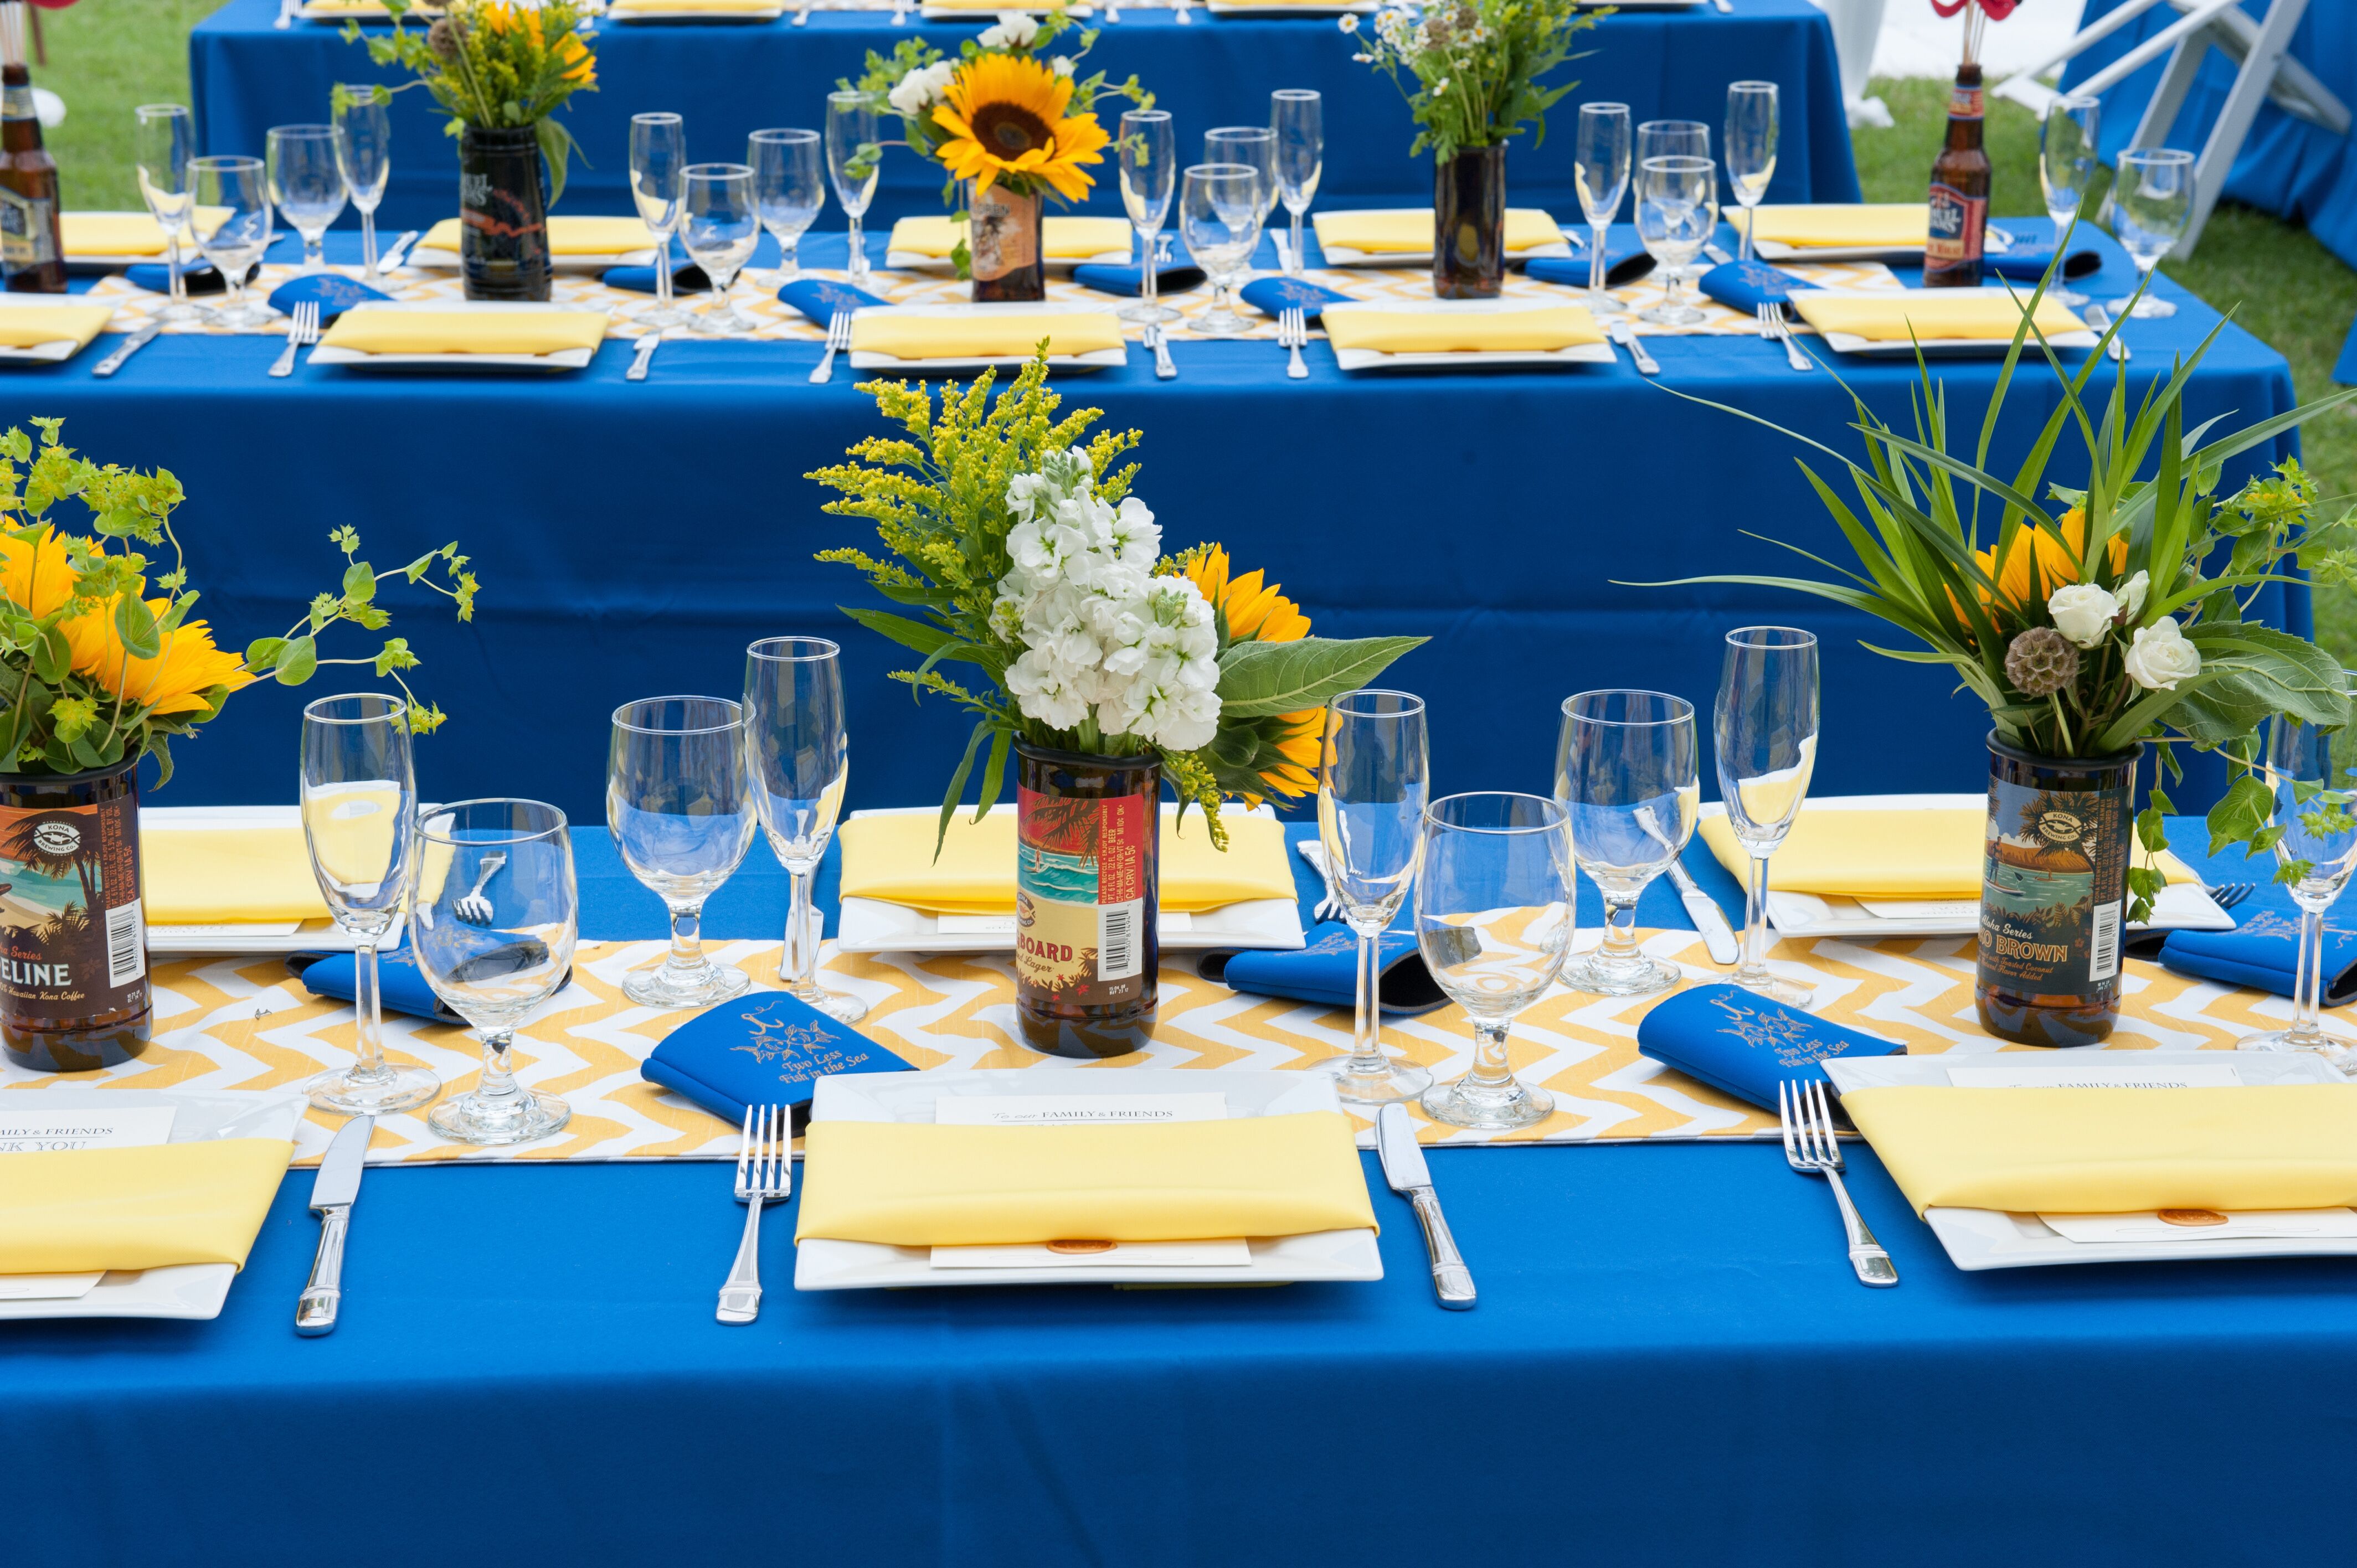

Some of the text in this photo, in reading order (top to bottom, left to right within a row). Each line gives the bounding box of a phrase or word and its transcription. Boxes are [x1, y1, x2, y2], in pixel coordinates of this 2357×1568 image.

[2053, 813, 2072, 822] KONA
[48, 824, 70, 833] KONA
[2042, 827, 2066, 840] BREWING
[38, 839, 65, 852] BREWING
[123, 845, 135, 901] CA CRV IA 5¢
[1125, 845, 1135, 899] CA CRV IA 5¢
[2114, 885, 2121, 897] CA
[1982, 914, 2033, 940] Aloha Series
[11, 946, 43, 961] Series
[1996, 934, 2068, 963] BROWN
[1024, 954, 1053, 973] Lager
[2000, 957, 2025, 969] Toasted
[2026, 963, 2054, 974] Coconut
[1998, 964, 2018, 977] Flavor
[2019, 970, 2043, 982] Added
[8, 986, 37, 999] Hawaiian
[39, 991, 59, 1000] Kona
[61, 990, 85, 1002] Coffee
[1774, 1039, 1823, 1056] Two Less
[1811, 1050, 1830, 1061] the
[1828, 1040, 1849, 1055] Sea
[779, 1053, 869, 1084] Fish in the Sea
[781, 1050, 842, 1072] Two Less
[35, 1141, 88, 1151] YOU
